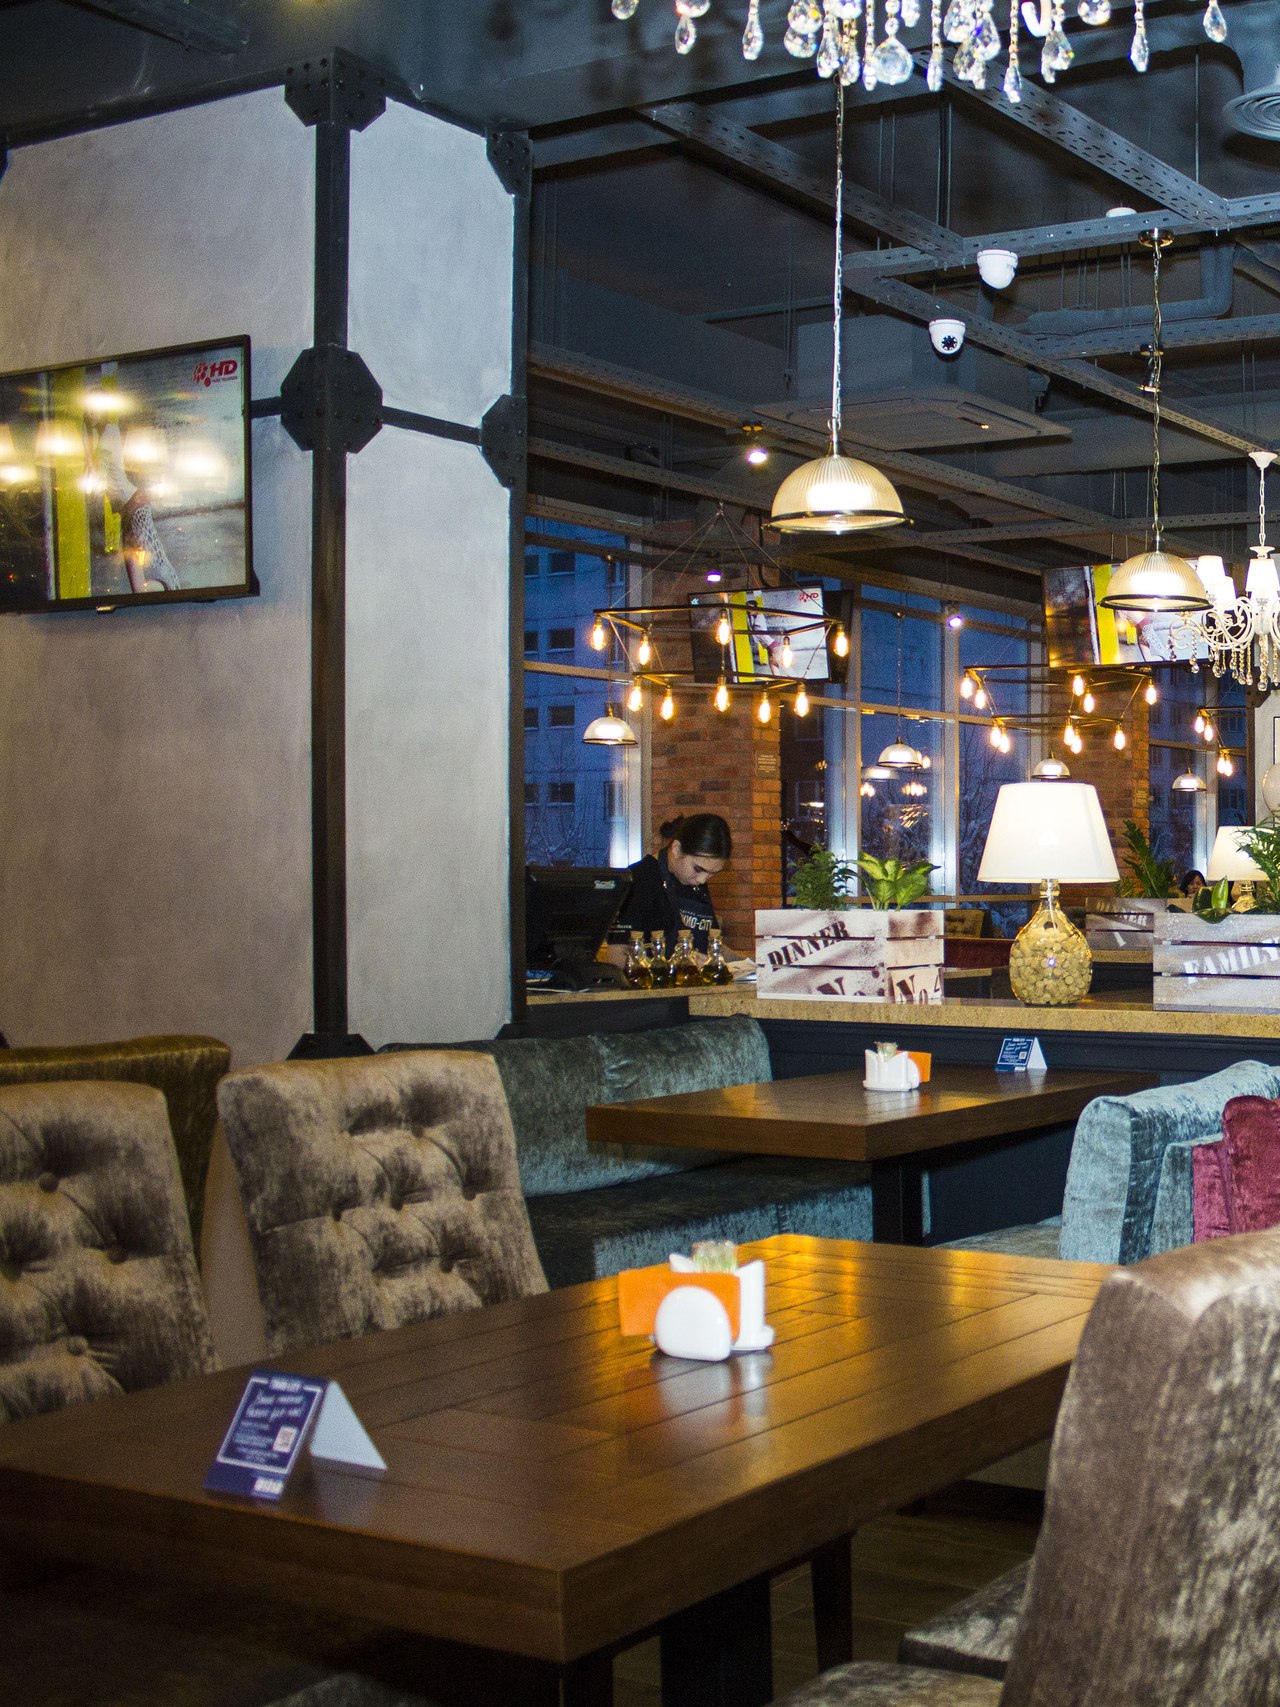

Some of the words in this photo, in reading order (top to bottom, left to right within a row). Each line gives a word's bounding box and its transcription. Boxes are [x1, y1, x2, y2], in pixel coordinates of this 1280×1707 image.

[210, 360, 238, 377] HD
[767, 921, 850, 972] DINNER
[1183, 936, 1280, 985] FAMILY
